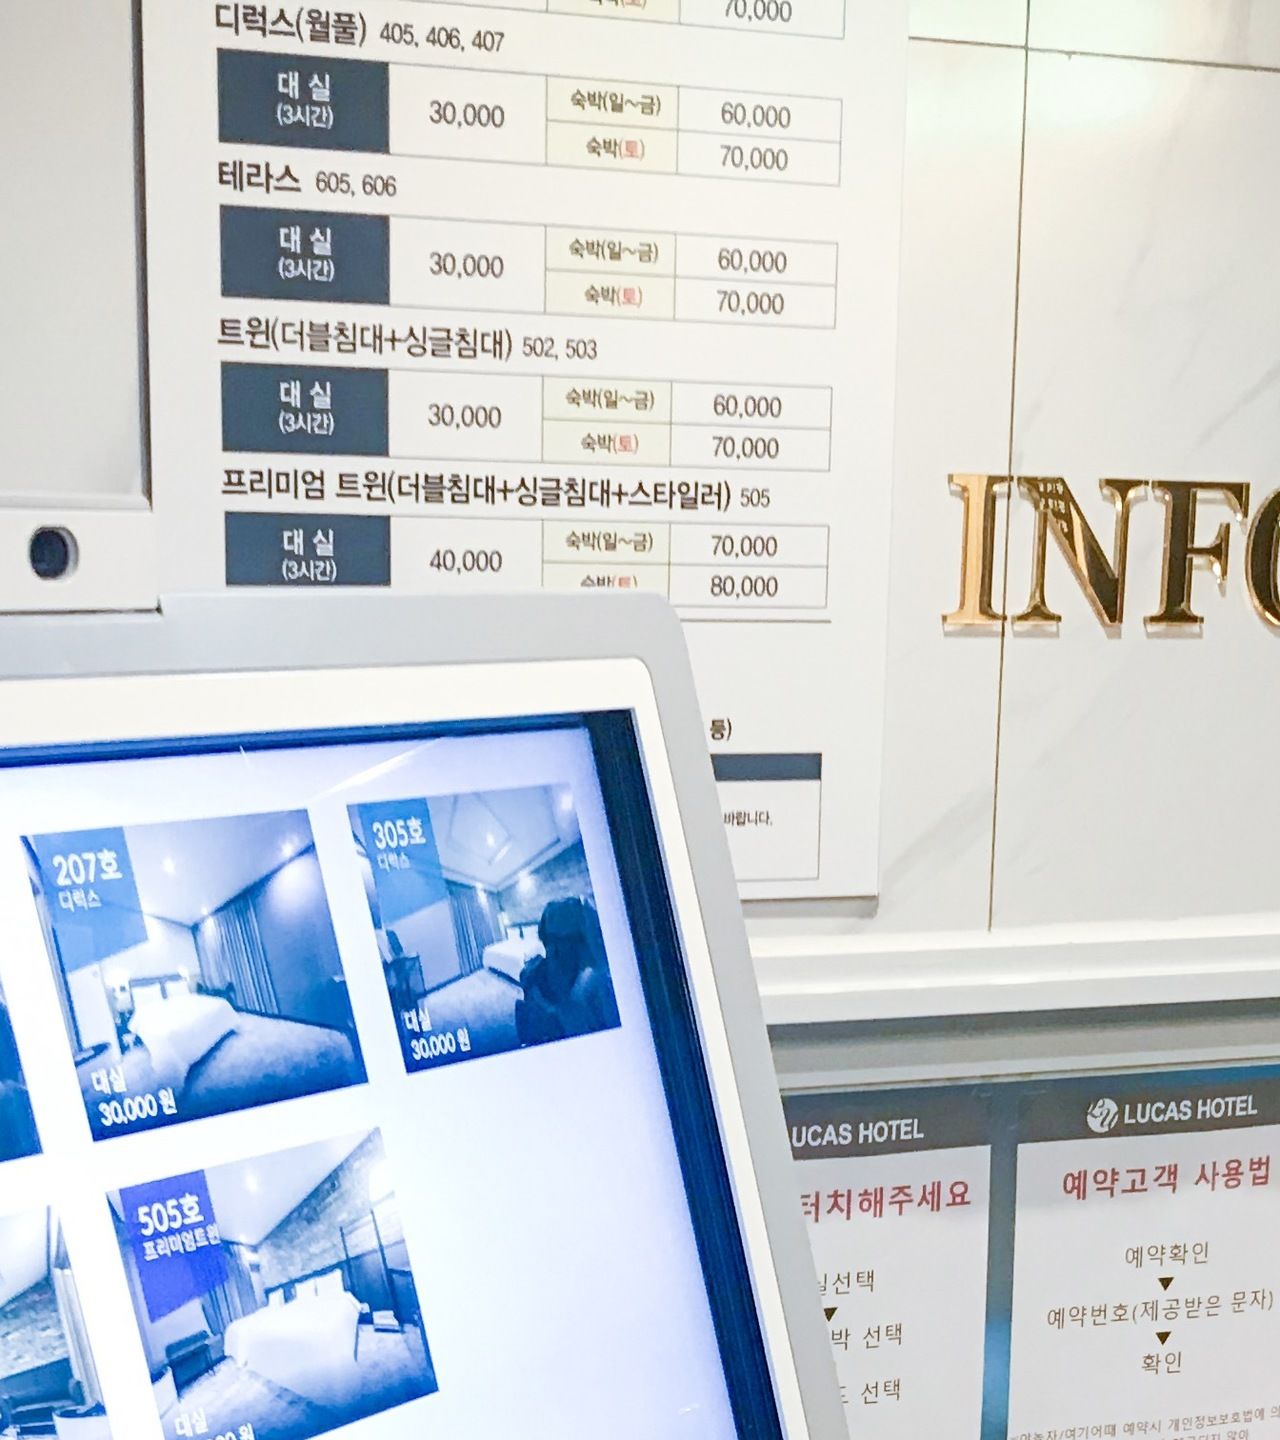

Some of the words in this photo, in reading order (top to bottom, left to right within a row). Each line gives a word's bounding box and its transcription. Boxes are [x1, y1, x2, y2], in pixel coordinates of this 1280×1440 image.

[215, 2, 367, 47] 디럭스(월풀)
[380, 22, 419, 48] 405,
[426, 26, 465, 52] 406,
[472, 31, 505, 52] 407
[276, 104, 334, 129] (3시간)
[429, 100, 505, 128] 30,000
[721, 103, 791, 129] 60,000
[586, 136, 645, 162] 숙박(토)
[720, 144, 788, 172] 70,000
[219, 161, 301, 194] 테라스
[315, 172, 356, 199] 605,
[362, 175, 397, 196] 606
[278, 258, 335, 283] (3시간)
[429, 253, 504, 282] 30,000
[717, 248, 787, 275] 60,000
[585, 285, 643, 308] 숙박(토)
[716, 290, 784, 316] 70,000
[522, 335, 559, 362] 502,
[565, 338, 598, 360] 503
[427, 403, 502, 430] 30,000
[713, 393, 782, 420] 60,000
[278, 411, 335, 436] (3시간)
[581, 431, 639, 456] 숙박(토)
[711, 435, 780, 462] 70,000
[221, 468, 324, 501] 프리미엄
[739, 487, 771, 509] 505
[710, 534, 778, 560] 70,000
[281, 558, 337, 583] (3시간)
[429, 549, 503, 576] 40,000
[710, 574, 779, 600] 80,000
[372, 816, 427, 849] 305호
[53, 847, 123, 887] 207호
[410, 1033, 456, 1061] 30,000
[99, 1095, 159, 1127] 30,000
[1124, 1099, 1193, 1126] LUCAS
[1197, 1094, 1257, 1120] HOTEL
[858, 1117, 924, 1144] HOTEL
[1063, 1162, 1179, 1202] 예약고객
[1194, 1155, 1272, 1193] 사용법
[137, 1192, 205, 1234] 505호
[1125, 1240, 1210, 1269] 예약확인
[1231, 1289, 1275, 1315] 문자)
[863, 1322, 903, 1349] 선택
[1141, 1351, 1183, 1376] 확인
[861, 1378, 901, 1405] 선택
